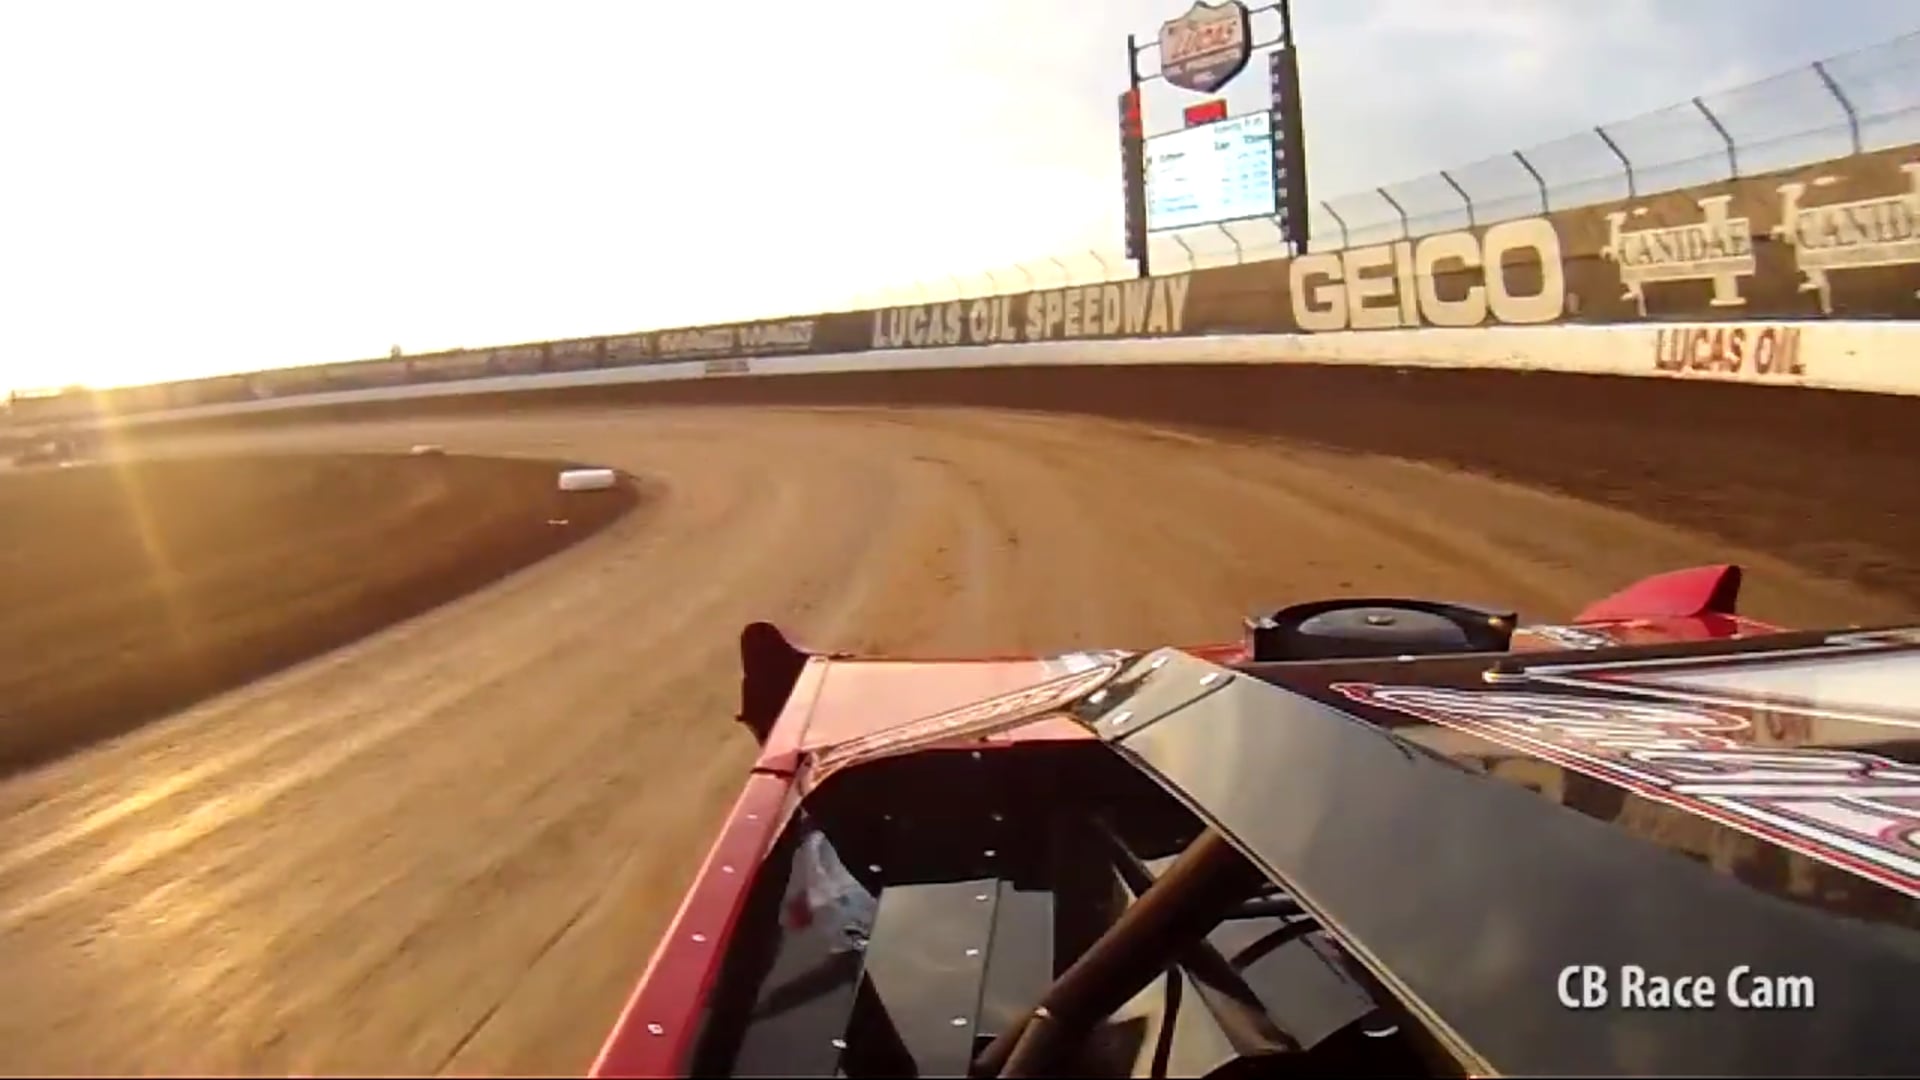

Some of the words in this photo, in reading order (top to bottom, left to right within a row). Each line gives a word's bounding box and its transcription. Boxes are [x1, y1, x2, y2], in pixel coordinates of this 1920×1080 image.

[1290, 219, 1564, 332] GEICO
[1621, 229, 1749, 266] CANIDAE
[872, 307, 962, 348] LUCAS
[969, 297, 1018, 342] OIL
[1027, 277, 1190, 340] SPEEDWAY
[1655, 327, 1746, 373] LUCAS
[1755, 326, 1806, 375] OIL
